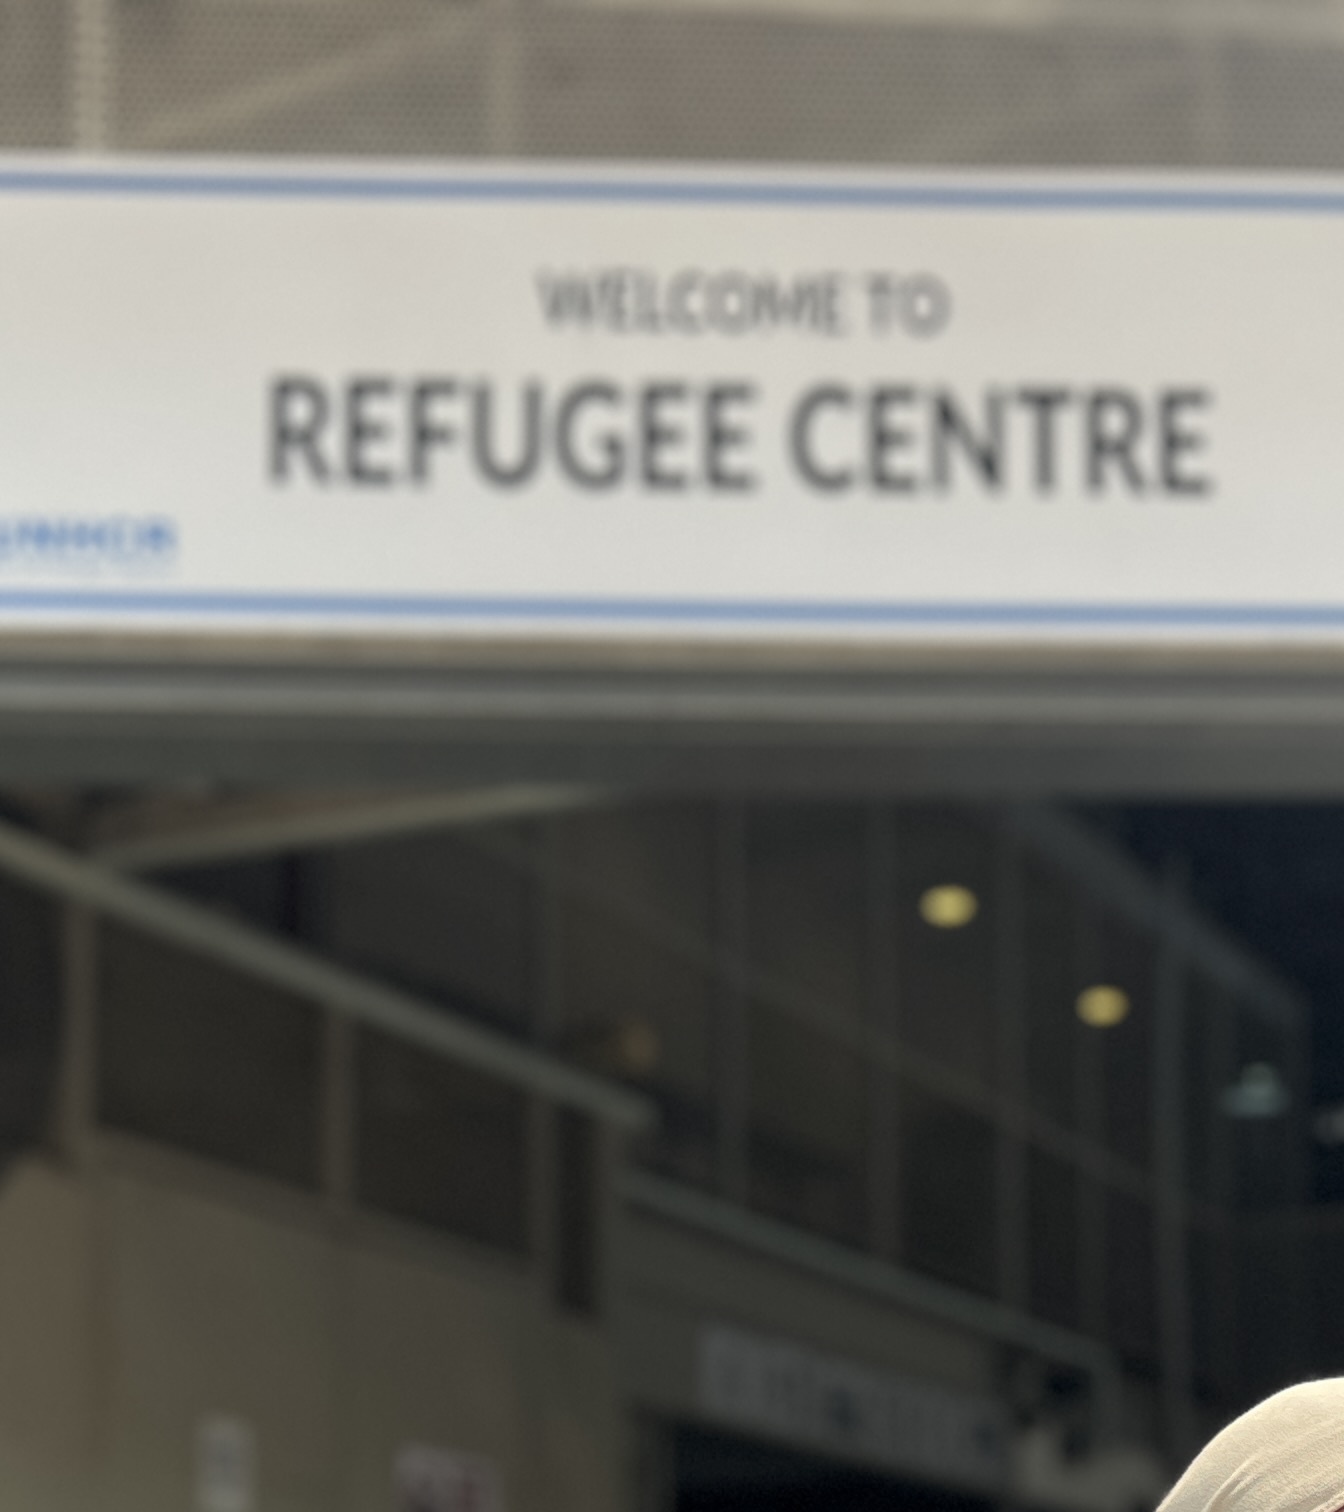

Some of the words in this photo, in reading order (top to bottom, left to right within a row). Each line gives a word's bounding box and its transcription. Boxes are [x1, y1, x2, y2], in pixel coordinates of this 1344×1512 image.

[534, 266, 848, 338] WELCOME
[862, 270, 954, 340] TO
[266, 374, 758, 493] REFUGEE
[786, 382, 1212, 496] CENTRE
